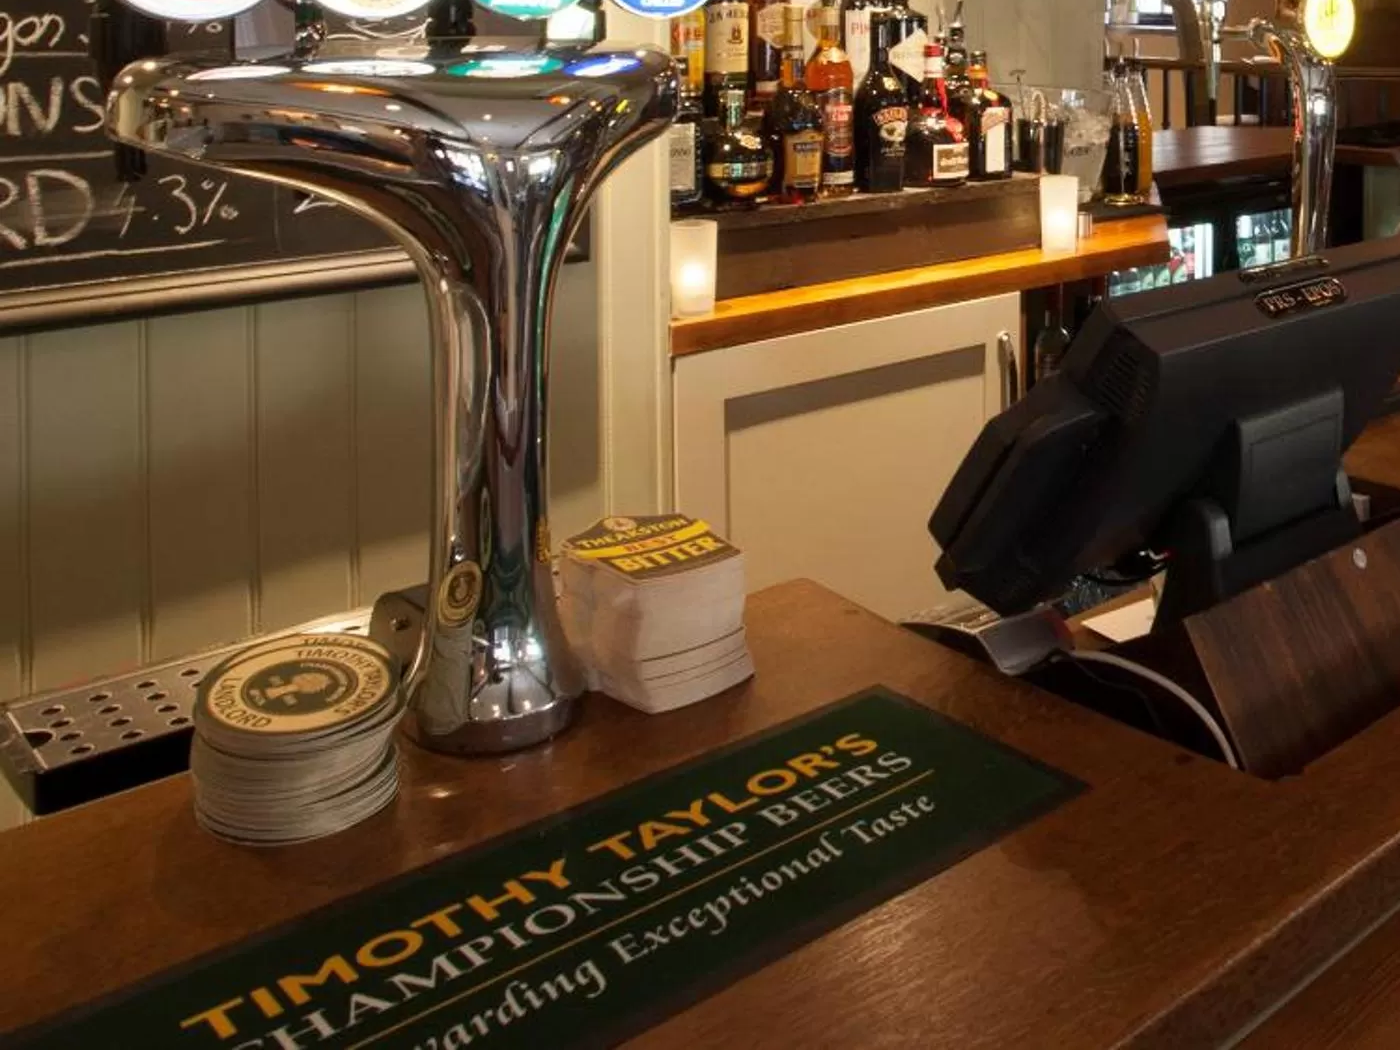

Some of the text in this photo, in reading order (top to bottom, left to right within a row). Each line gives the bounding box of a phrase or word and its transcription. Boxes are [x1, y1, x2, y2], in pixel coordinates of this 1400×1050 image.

[0, 76, 104, 137] NS
[574, 517, 689, 548] THEAKSTON
[610, 536, 726, 572] BITTER
[213, 677, 273, 728] LANDLORD
[179, 733, 878, 1040] TIMOTHY TAYLOR'S
[231, 749, 913, 1050] HAMPIONSHIP BEERS
[607, 832, 844, 965] Exceptional
[840, 792, 936, 845] Taste
